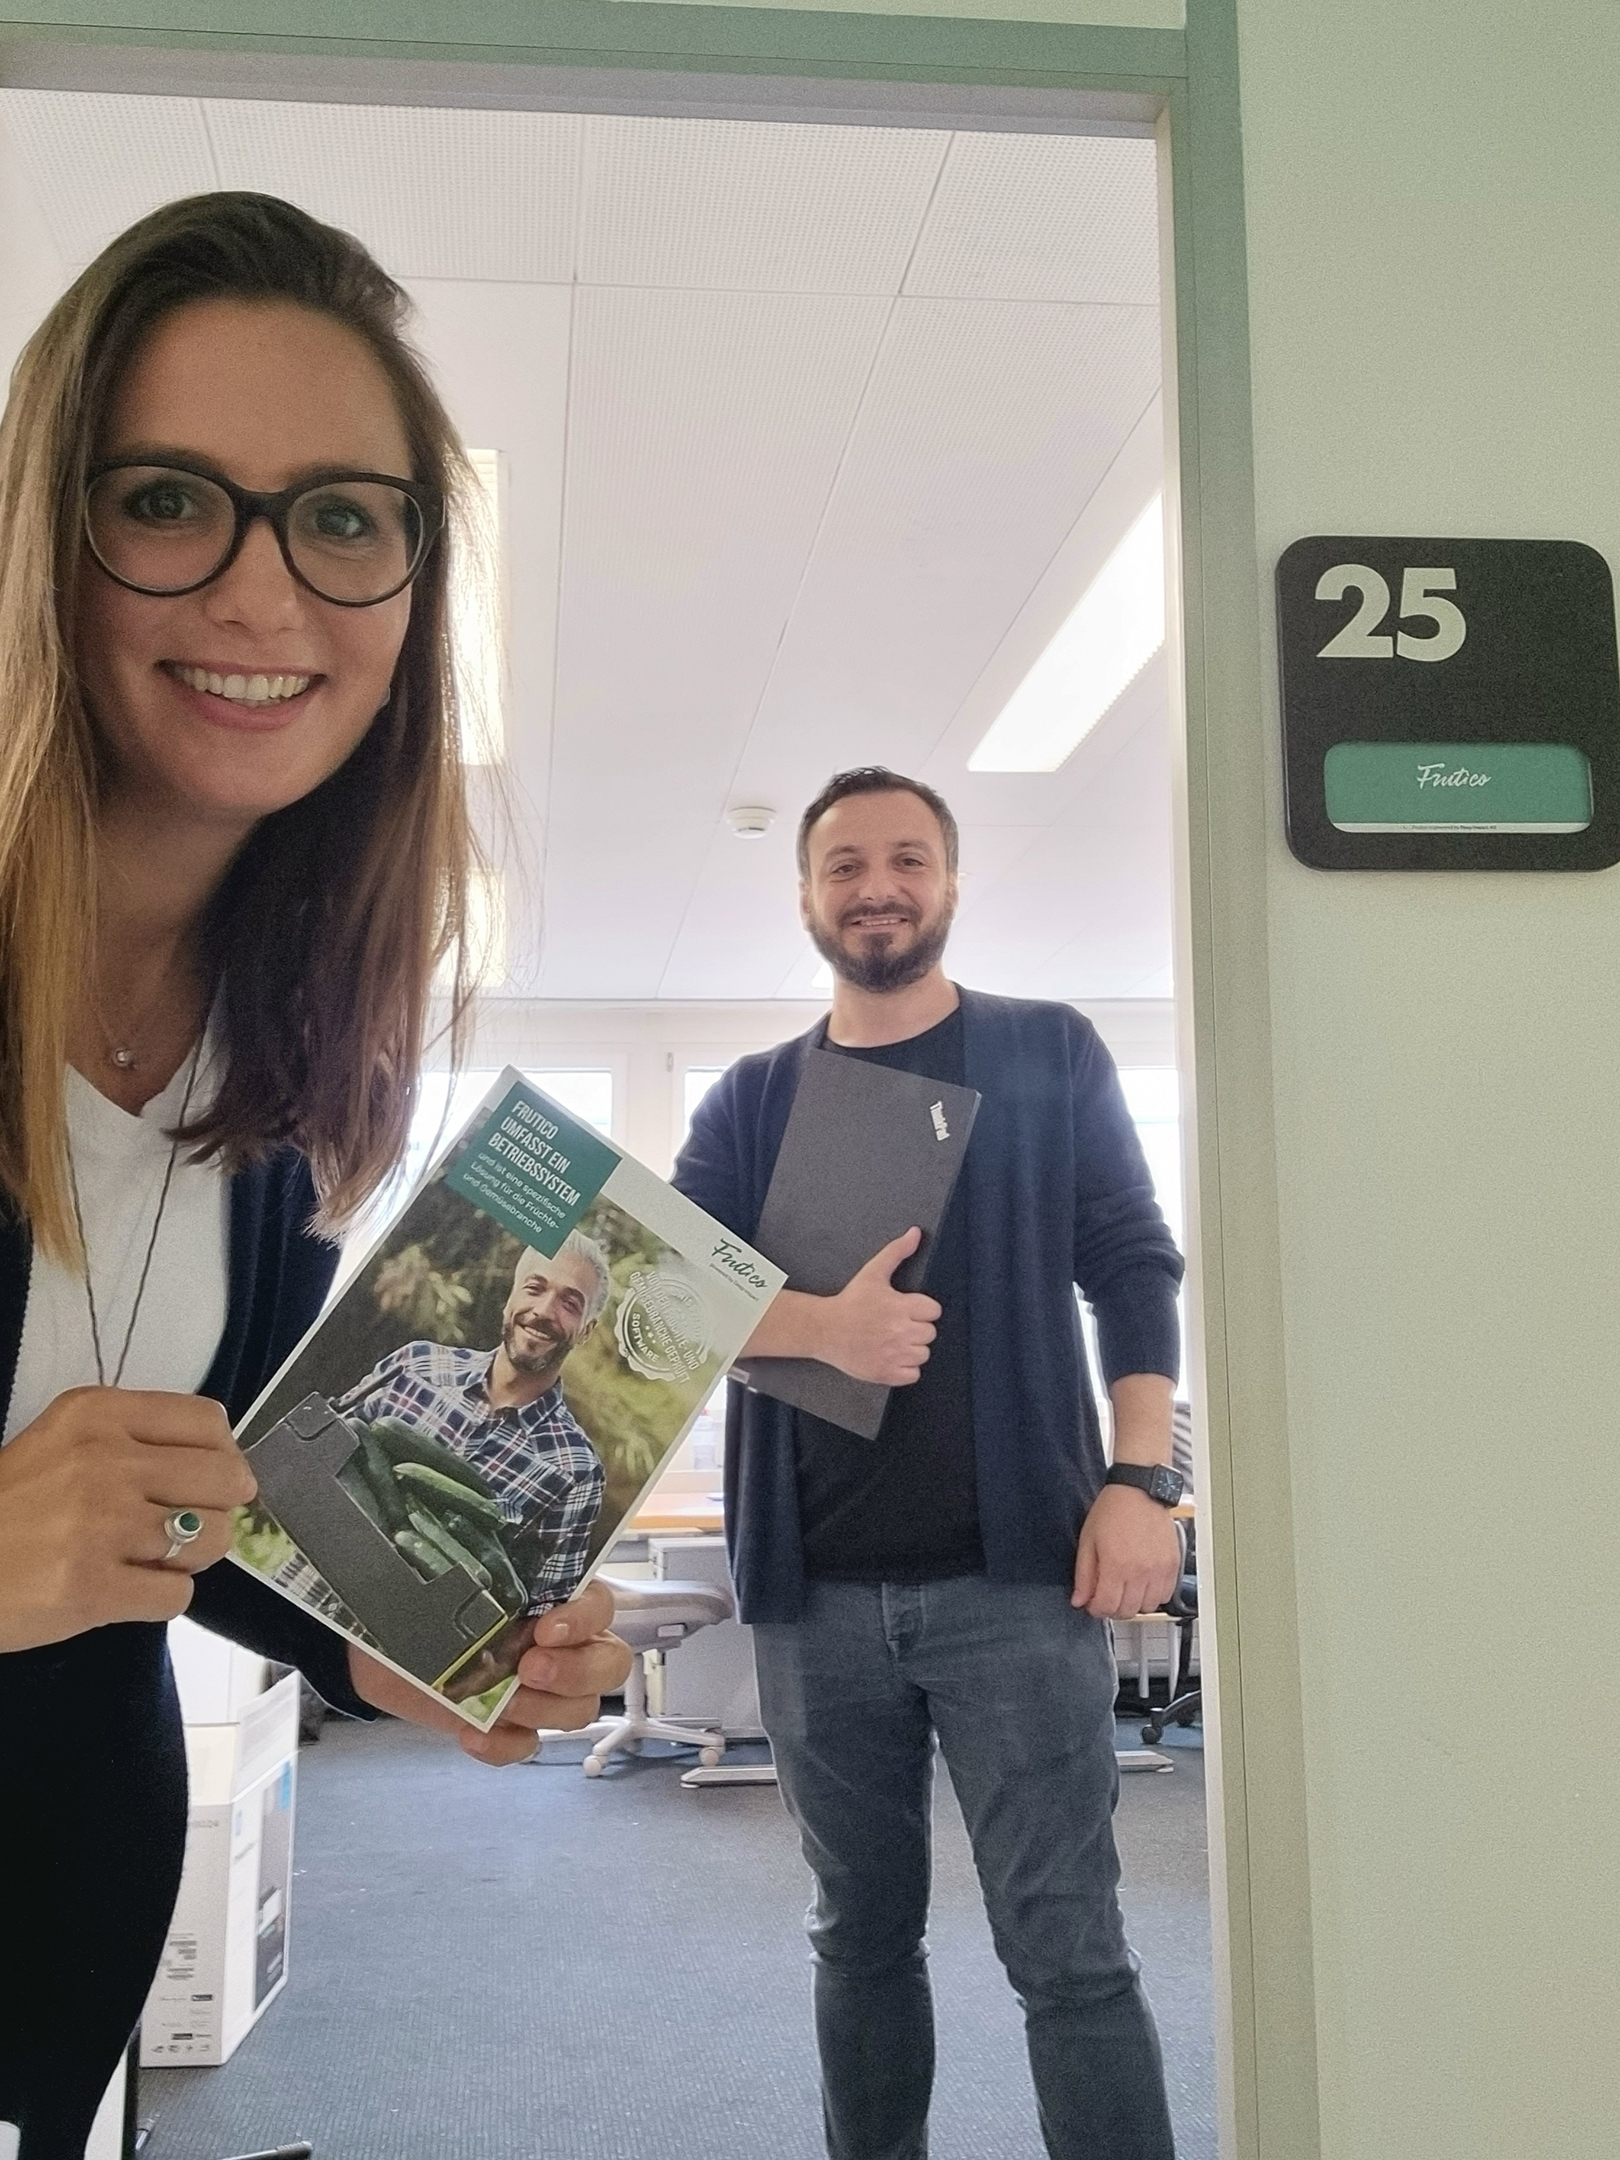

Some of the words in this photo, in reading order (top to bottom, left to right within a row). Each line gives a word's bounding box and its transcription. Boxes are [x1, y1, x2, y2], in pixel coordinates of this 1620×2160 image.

[1315, 563, 1467, 662] 25
[1416, 763, 1491, 789] Frutico
[500, 1116, 553, 1160] UMFASST
[548, 1151, 571, 1174] EIN
[511, 1100, 559, 1140] FRUTICO
[471, 1161, 501, 1188] Lösung
[501, 1182, 513, 1196] für
[512, 1192, 525, 1205] die
[525, 1200, 560, 1230] Früchte-
[478, 1152, 495, 1167] und
[495, 1162, 506, 1175] ist
[505, 1172, 523, 1188] eine
[523, 1184, 566, 1219] spezifische
[488, 1132, 581, 1206] BETRIEBSSYSTEM
[463, 1173, 479, 1187] und
[479, 1182, 543, 1234] Gemüsebranche
[711, 1238, 768, 1288] Frutico
[632, 1313, 659, 1362] SOFTWARE
[683, 1350, 699, 1370] UND
